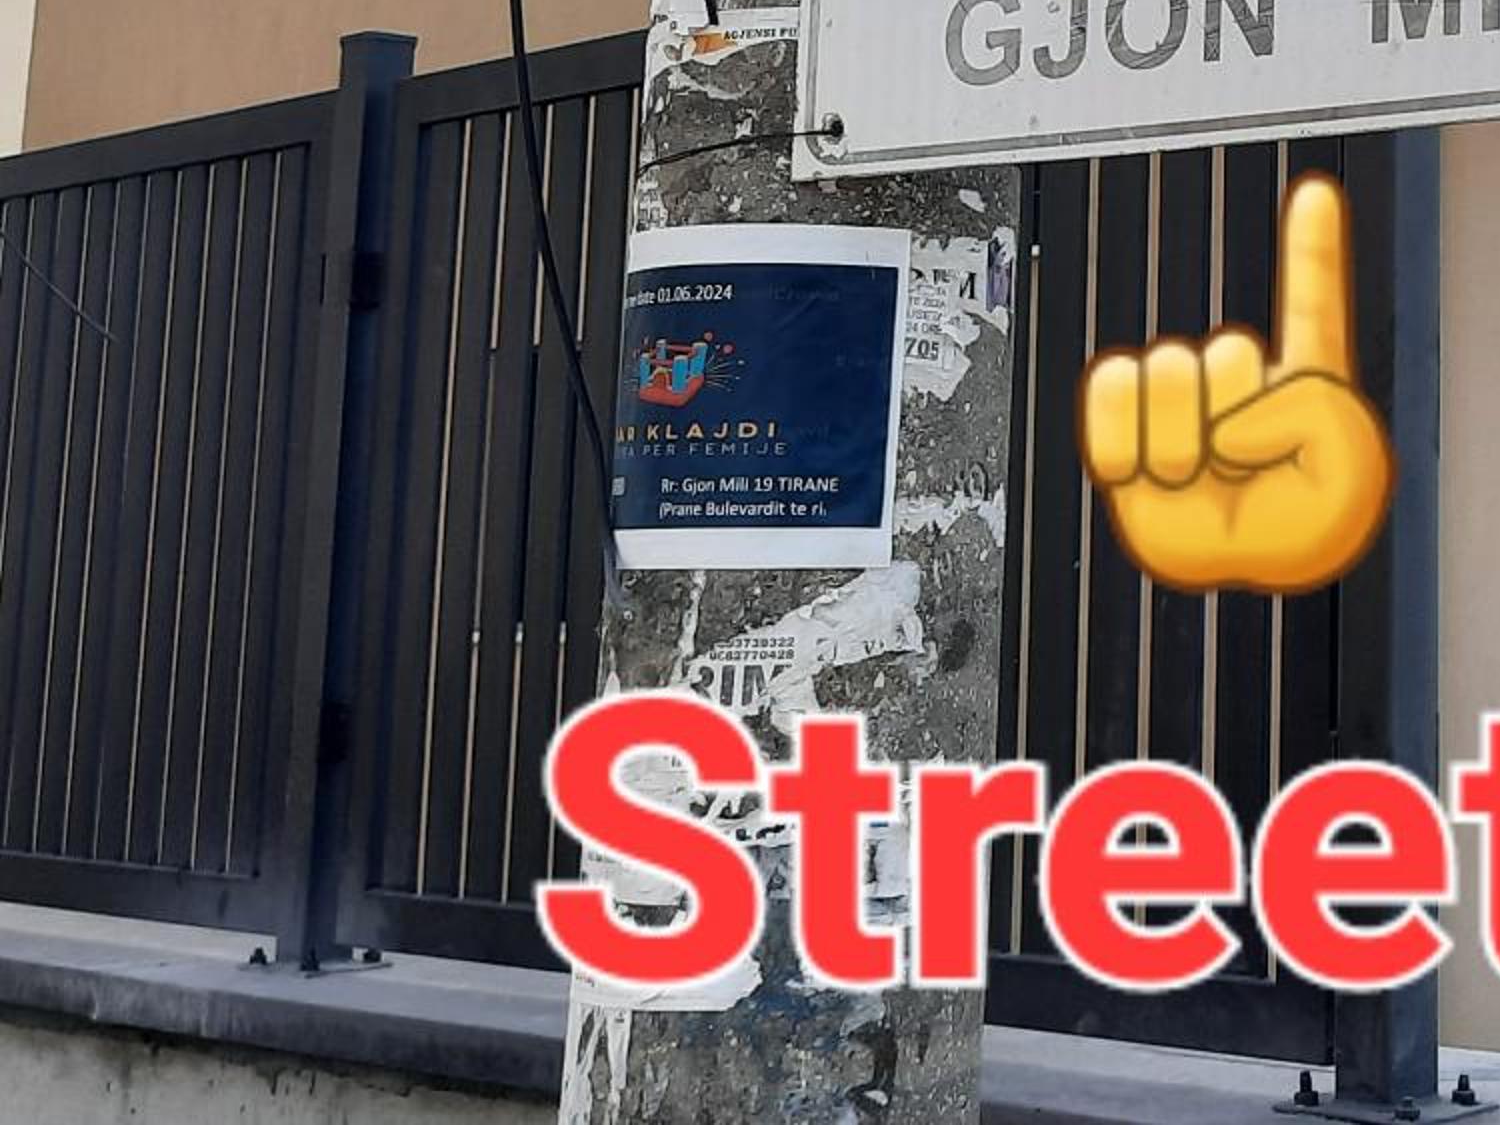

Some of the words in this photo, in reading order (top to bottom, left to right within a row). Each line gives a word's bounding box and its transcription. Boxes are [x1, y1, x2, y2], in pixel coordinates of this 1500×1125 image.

[657, 284, 733, 304] 01.06.2024
[647, 422, 776, 441] KLAJDI
[643, 444, 677, 457] PER
[689, 442, 788, 456] FEMIJE
[661, 477, 679, 493] Rr:
[682, 477, 715, 496] Gjon
[719, 476, 749, 492] Mili
[754, 477, 773, 492] 19
[777, 476, 840, 492] TIRANE
[659, 501, 702, 519] (Prane
[706, 500, 785, 517] Bulevardit
[790, 501, 807, 517] te
